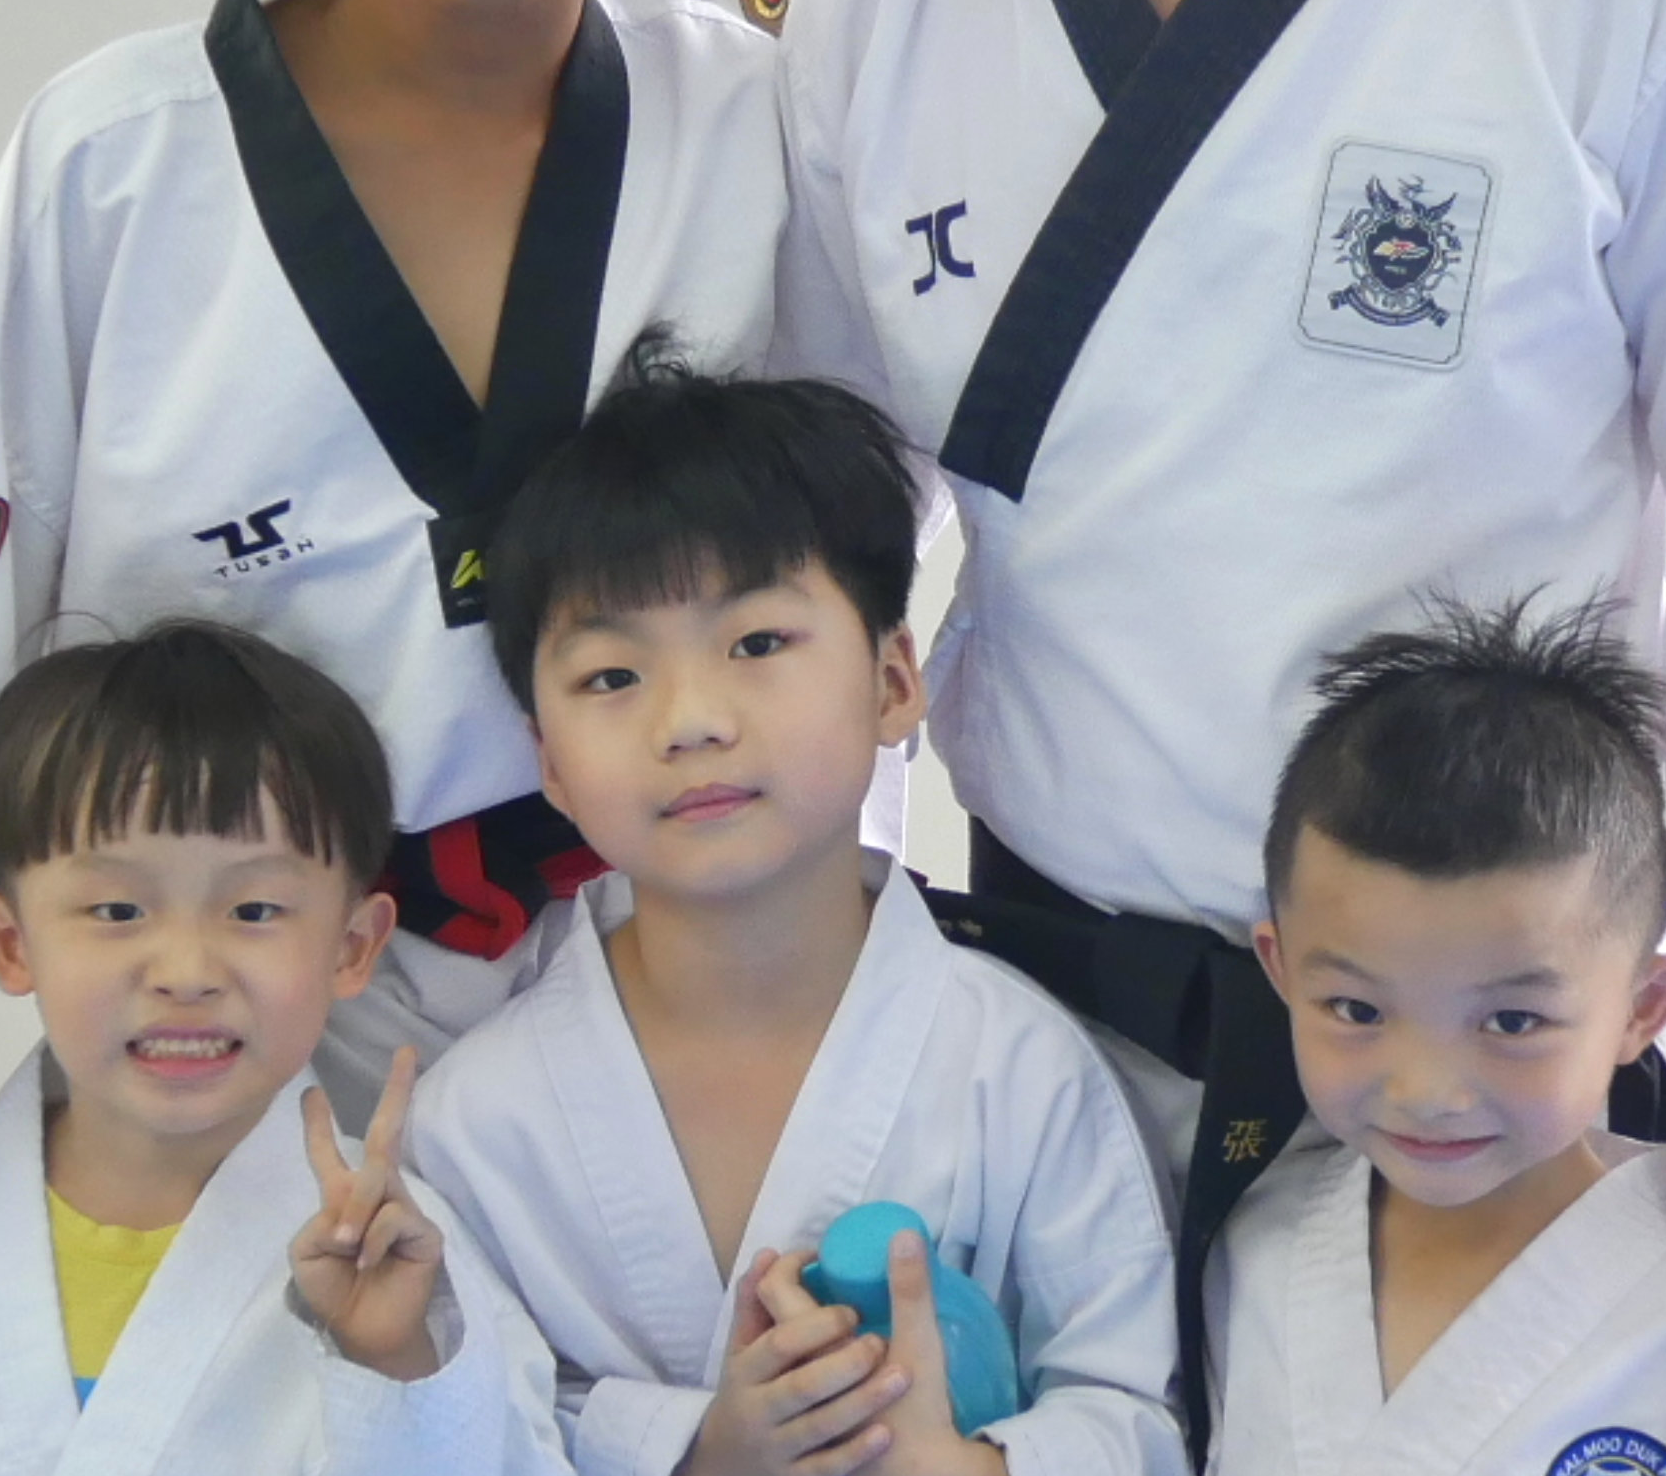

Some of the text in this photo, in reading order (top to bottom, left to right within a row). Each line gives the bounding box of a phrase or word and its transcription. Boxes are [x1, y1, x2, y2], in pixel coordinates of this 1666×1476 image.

[1221, 1118, 1268, 1164] 張
[1583, 1435, 1623, 1458] MOO
[1624, 1439, 1663, 1467] DUK
